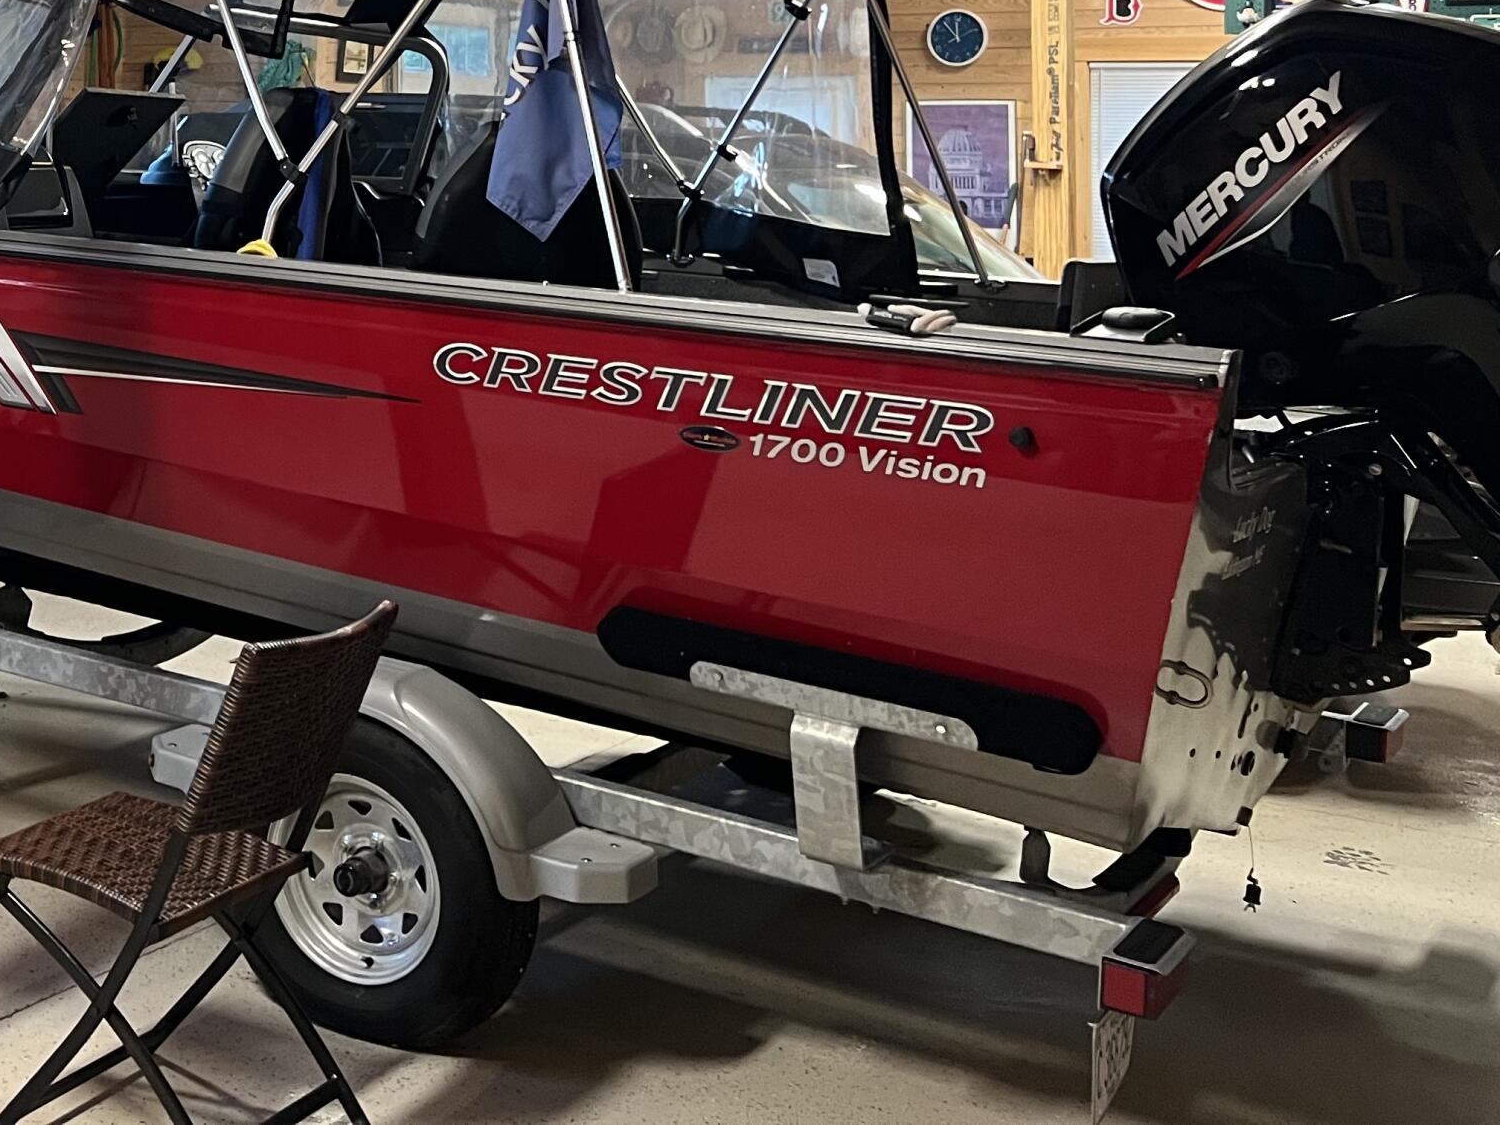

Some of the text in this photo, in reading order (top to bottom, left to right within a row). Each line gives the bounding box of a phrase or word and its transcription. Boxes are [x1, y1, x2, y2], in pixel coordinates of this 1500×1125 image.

[1048, 41, 1059, 65] PSL
[1156, 70, 1344, 267] MERCURY
[432, 342, 994, 453] CRESTLINER
[749, 432, 845, 468] 1700
[859, 445, 988, 489] Vision
